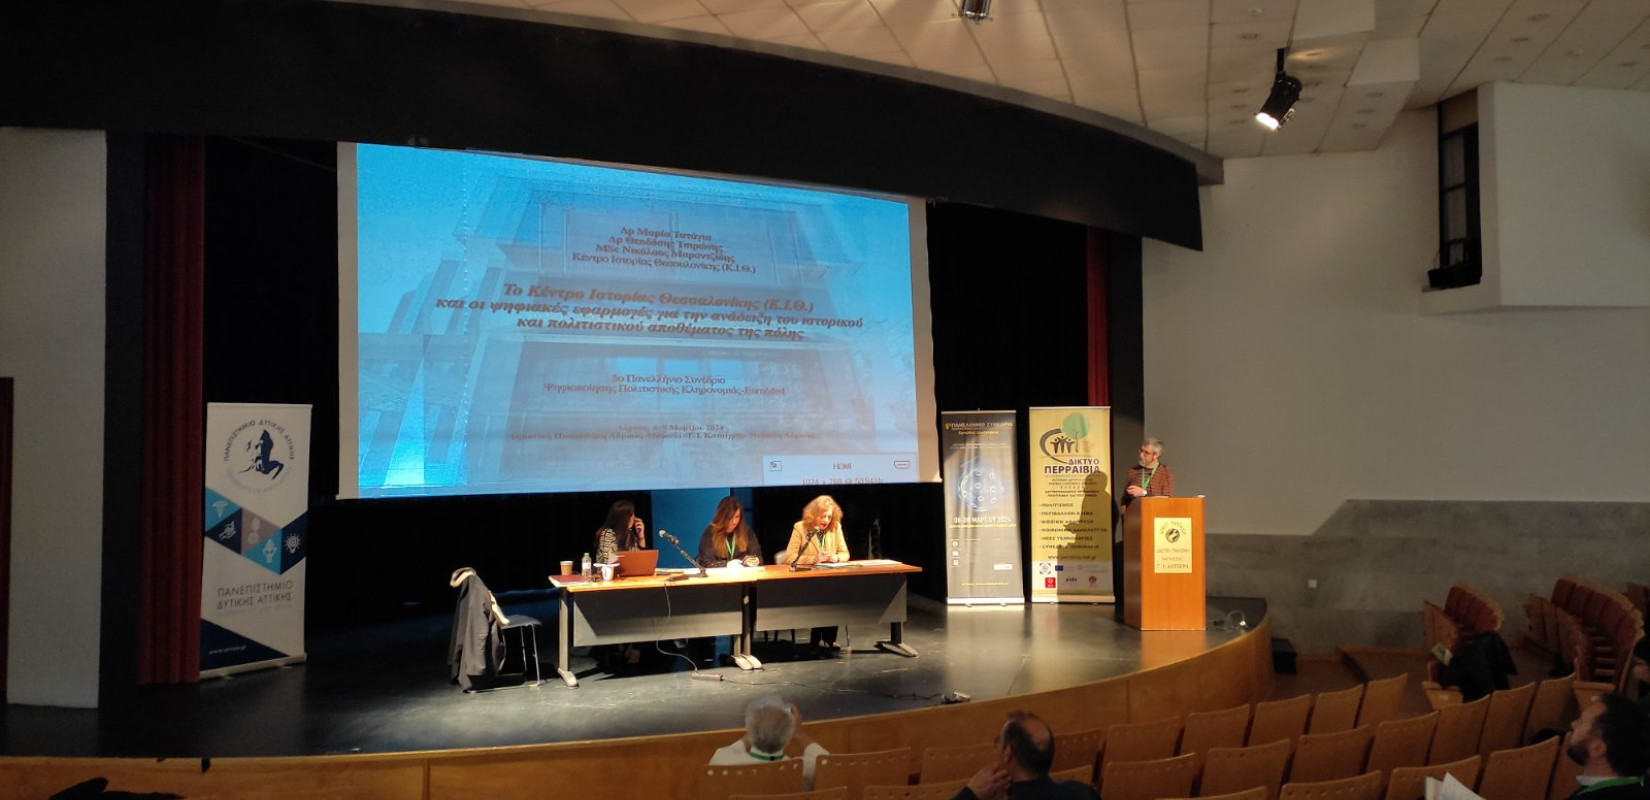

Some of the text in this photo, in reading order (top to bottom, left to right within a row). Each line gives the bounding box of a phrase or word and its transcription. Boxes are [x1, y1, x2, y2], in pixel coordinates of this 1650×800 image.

[572, 252, 609, 264] Κέντρο
[611, 255, 651, 267] Ιστορίας
[654, 258, 720, 273] Θεσσαλονίκης
[503, 283, 814, 314] Το Κέντρο Ιστορίας Θεσσαλονίκης (Κ.Ι.Θ.)
[435, 298, 864, 330] και οι ψηφιακές εφαρμογές για την ανάδειξη του ιστορικού
[516, 318, 805, 340] και πολιτιστικού αποθέματος της πόλης
[1044, 465, 1101, 474] ΠΕΡΡΑΙΒΙΑ
[1068, 458, 1100, 466] ΔΙΚΤΥΟ
[217, 580, 294, 597] ΠΑΝΕΠΙΣΤΗΜΙΟ
[217, 596, 255, 610] ΔΥΤΙΚΗΣ
[257, 592, 293, 604] ΑΤΤΙΚΗΣ
